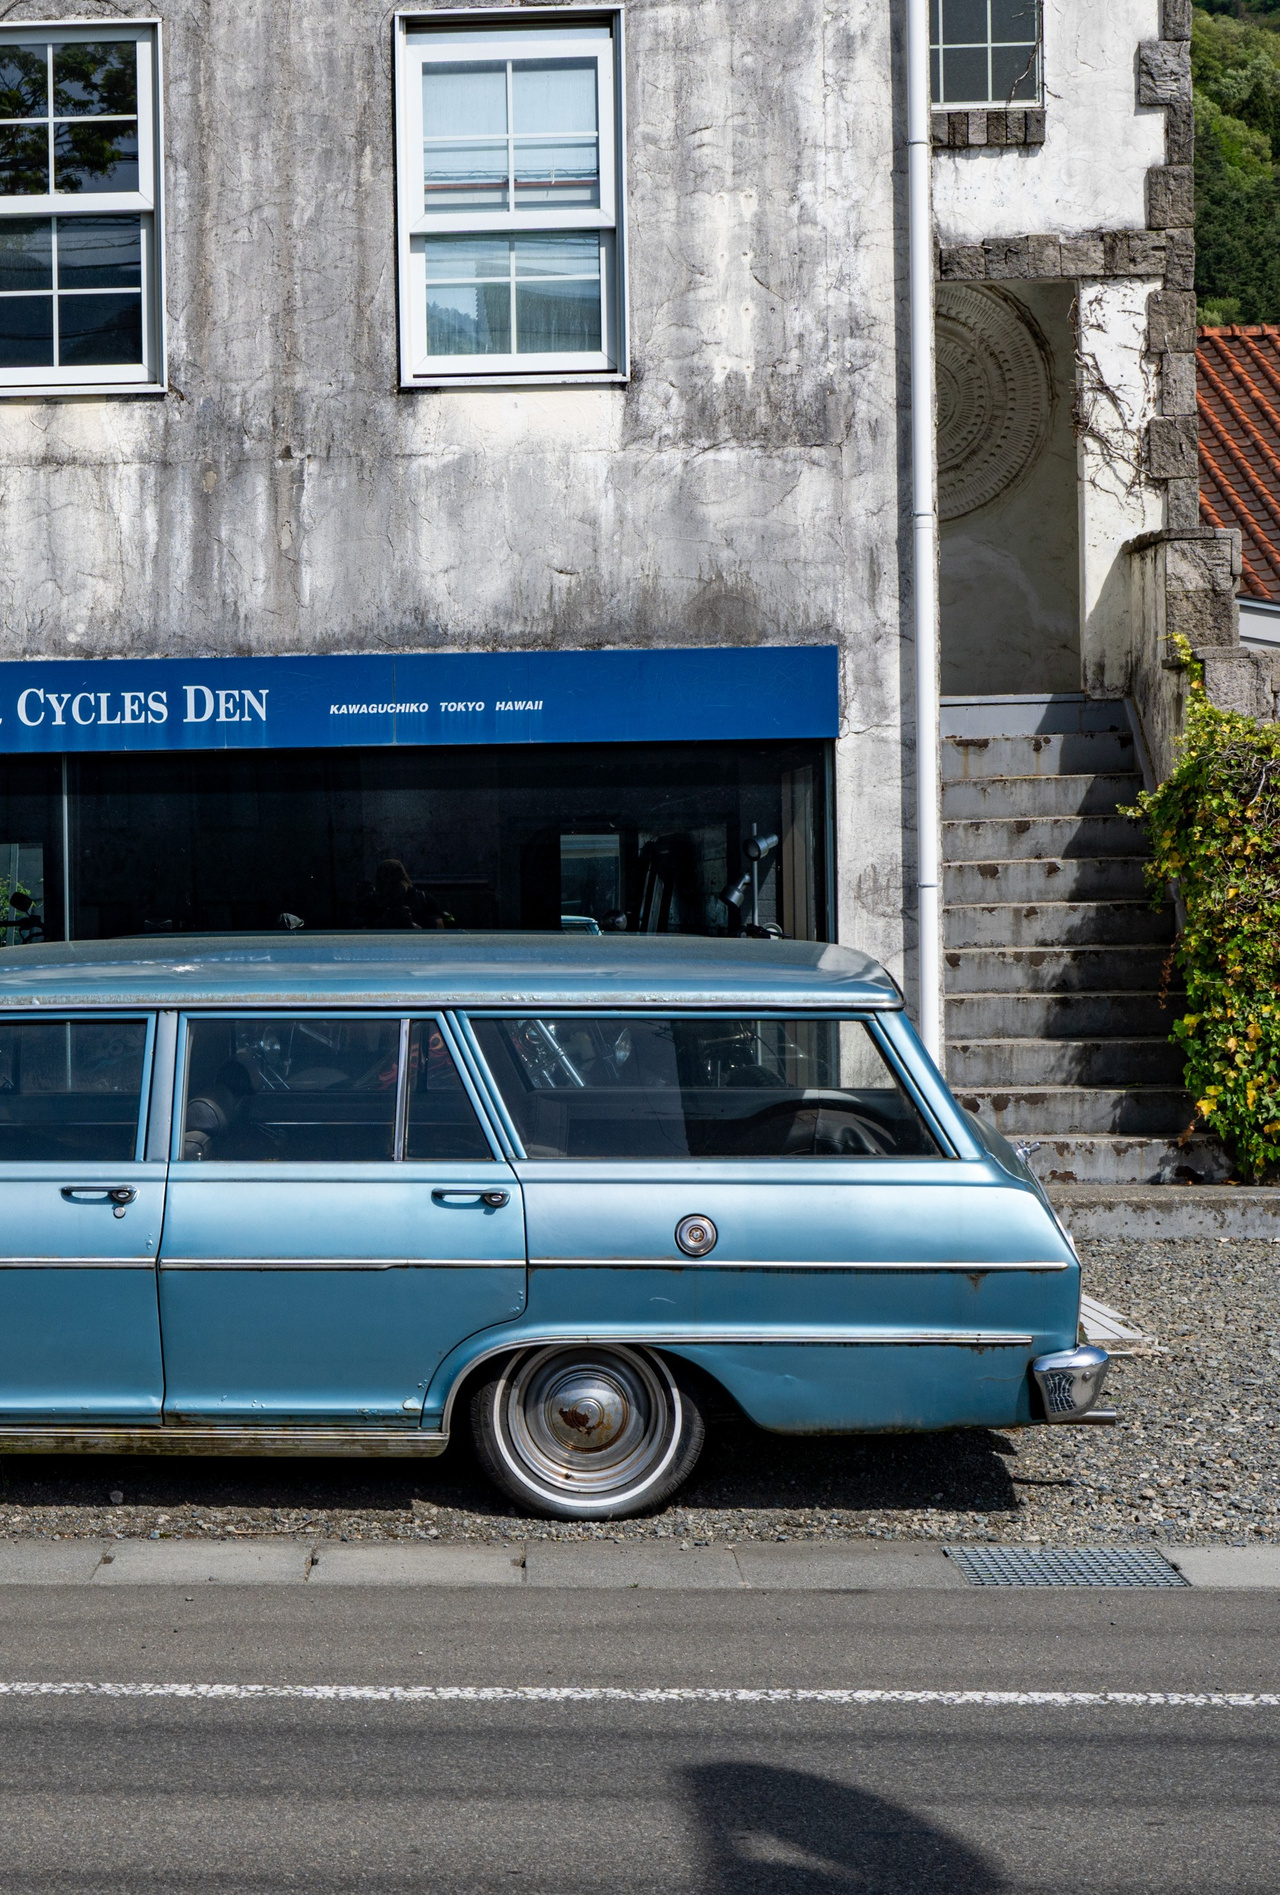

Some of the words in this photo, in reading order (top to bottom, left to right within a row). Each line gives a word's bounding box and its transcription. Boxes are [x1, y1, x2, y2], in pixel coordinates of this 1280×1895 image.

[17, 688, 169, 727] CYCLES
[182, 685, 270, 723] DEN
[329, 702, 429, 716] KAWAGUCHIKO
[439, 701, 485, 713] TOKYO
[495, 700, 544, 712] HAWAII
